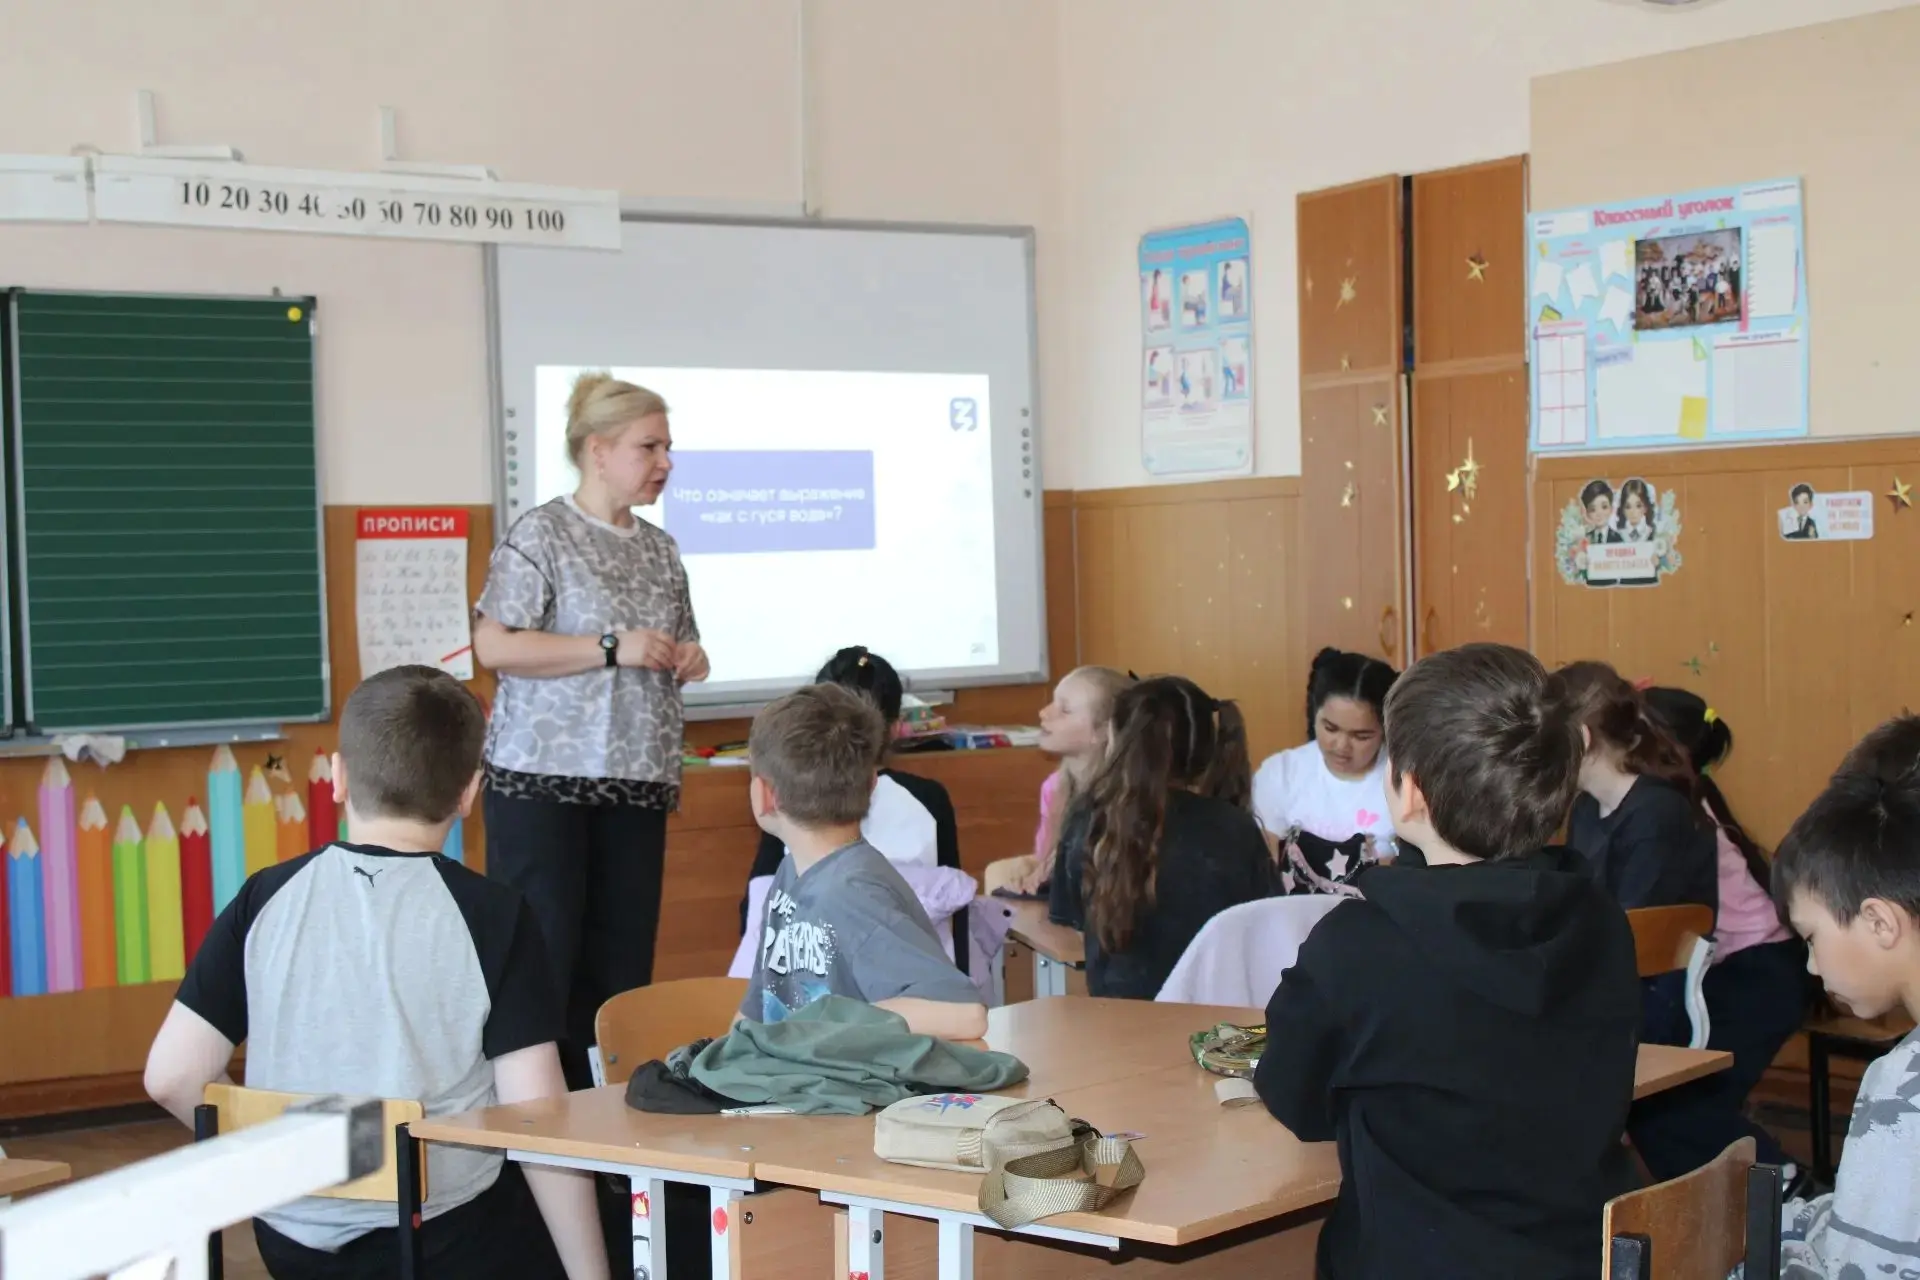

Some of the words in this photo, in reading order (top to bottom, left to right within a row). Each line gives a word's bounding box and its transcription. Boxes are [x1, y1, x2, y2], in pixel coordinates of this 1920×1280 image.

[181, 182, 211, 206] 10
[220, 185, 250, 209] 20
[259, 189, 289, 213] 30
[412, 202, 441, 225] 70
[449, 205, 477, 226] 80
[485, 207, 513, 230] 90
[525, 209, 566, 231] 100
[673, 487, 703, 503] Что
[363, 516, 455, 533] ПРОПИСИ
